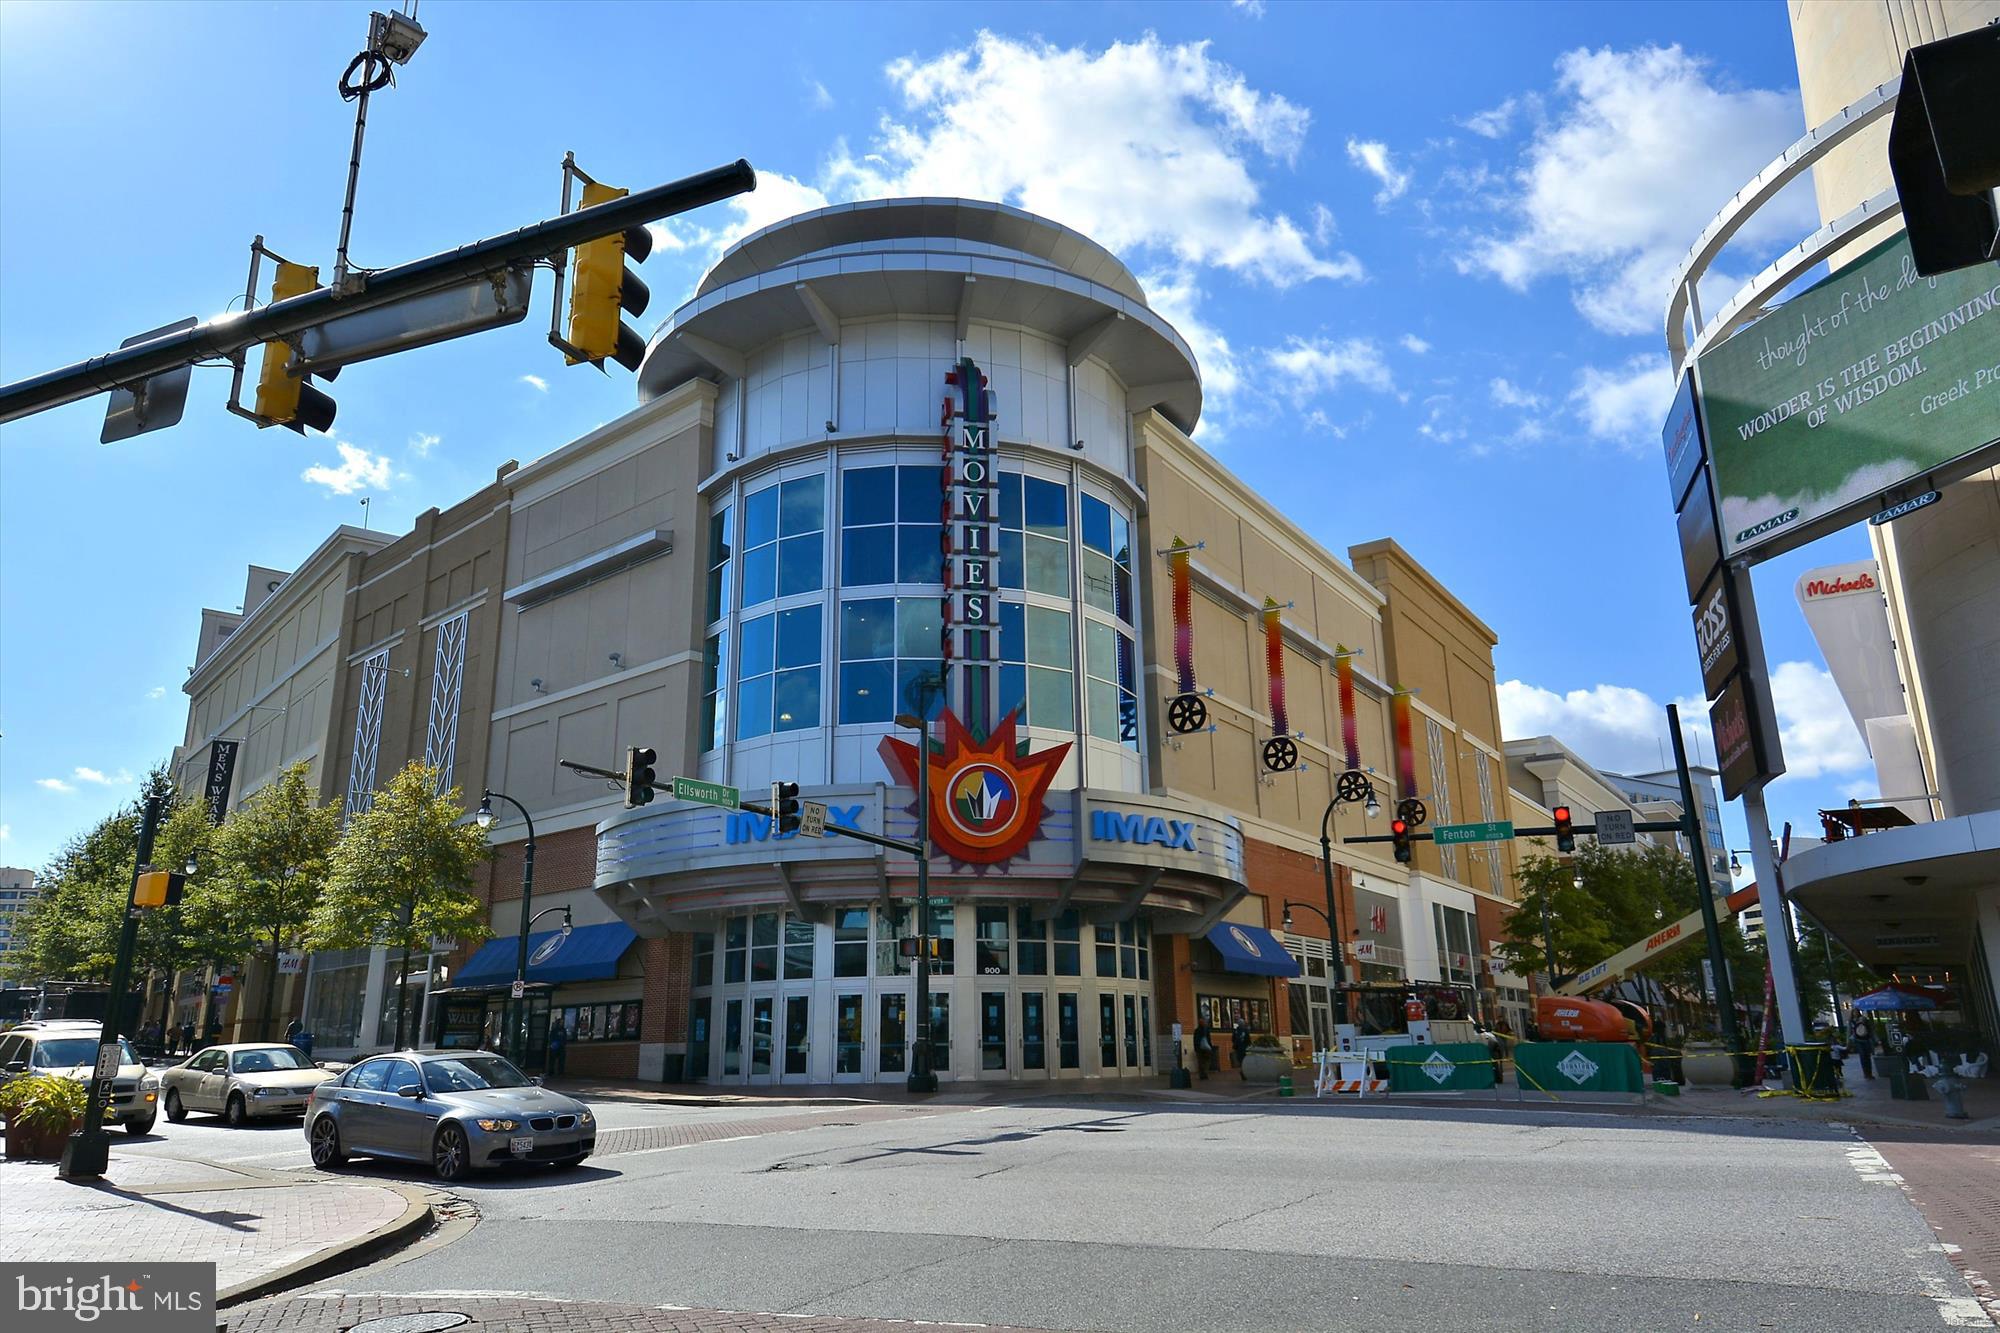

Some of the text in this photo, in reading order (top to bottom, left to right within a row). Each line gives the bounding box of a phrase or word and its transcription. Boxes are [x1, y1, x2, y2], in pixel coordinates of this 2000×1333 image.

[1757, 313, 1828, 370] thought
[1830, 291, 1851, 332] of
[1854, 276, 1893, 313] the
[1738, 391, 1813, 441] WONDER
[1816, 377, 1836, 401] IS
[1840, 354, 1881, 388] THE
[1807, 355, 1928, 429] OF WISDOM.
[1920, 378, 1970, 414] Greek
[1876, 494, 1929, 523] LAMAR
[962, 427, 986, 620] MOVIES
[1740, 510, 1793, 541] LAMAR
[1806, 572, 1875, 597] Michaels
[1696, 587, 1727, 658] ROSS
[215, 743, 231, 783] MEN'S
[678, 785, 730, 801] Ellsworth Dr
[726, 805, 864, 845] IMX
[806, 815, 821, 824] TURN
[810, 807, 820, 815] NO
[802, 824, 811, 832] ON
[1091, 810, 1199, 851] IMAX
[1443, 823, 1496, 840] Fenton St
[1601, 832, 1632, 840] ON RED
[1604, 823, 1626, 831] TURN
[1645, 923, 1681, 952] AHERN
[984, 966, 1001, 974] 900
